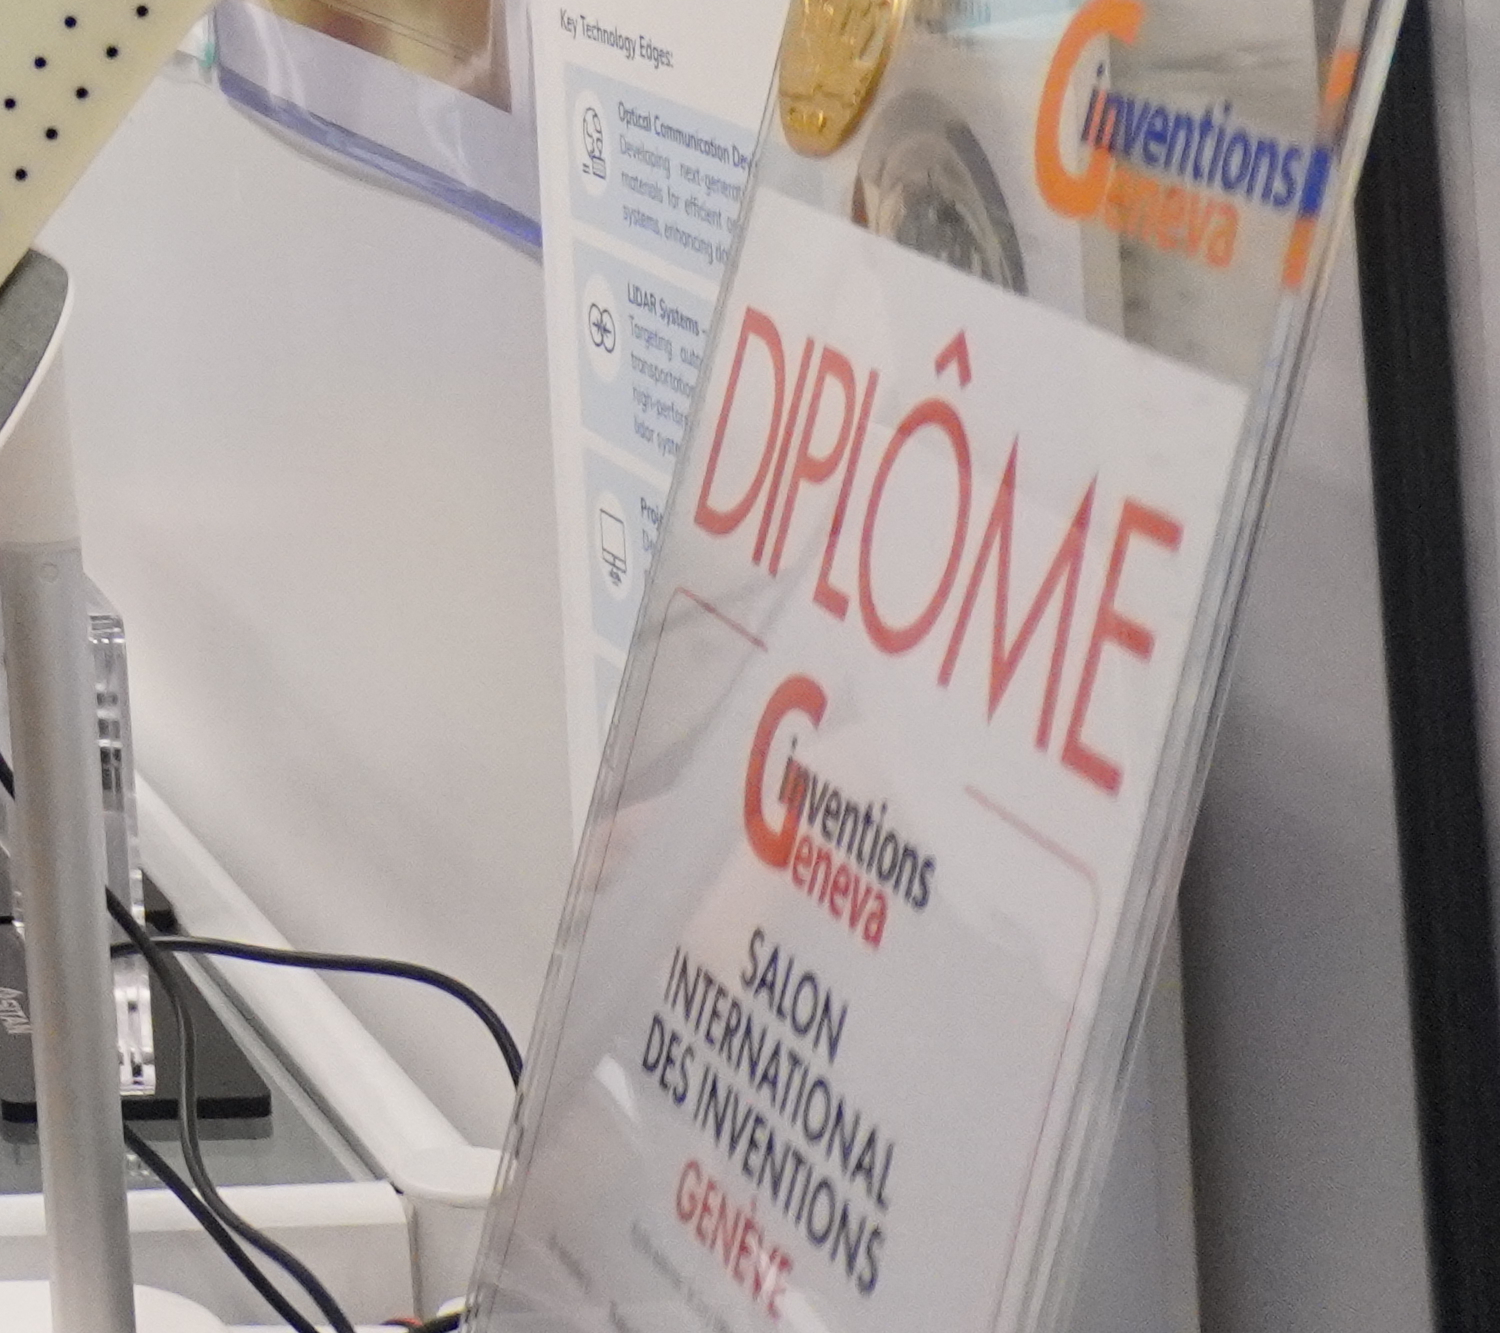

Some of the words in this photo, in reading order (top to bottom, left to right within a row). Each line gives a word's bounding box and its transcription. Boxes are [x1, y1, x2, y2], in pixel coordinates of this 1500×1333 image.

[560, 7, 578, 41] Key
[580, 15, 637, 61] Technology
[639, 35, 674, 70] Edges:
[618, 99, 652, 131] Optical
[653, 114, 730, 163] Communication
[621, 170, 664, 204] materials
[667, 184, 680, 210] for
[1081, 61, 1304, 210] inventions
[659, 298, 700, 336] Systems
[694, 305, 1185, 797] DIPLÔME
[778, 735, 936, 911] inventions
[740, 927, 848, 1065] SALON
[664, 944, 895, 1211] INTERNATIONAL
[642, 1013, 695, 1107] DES
[693, 1066, 885, 1296] INVENTIONS
